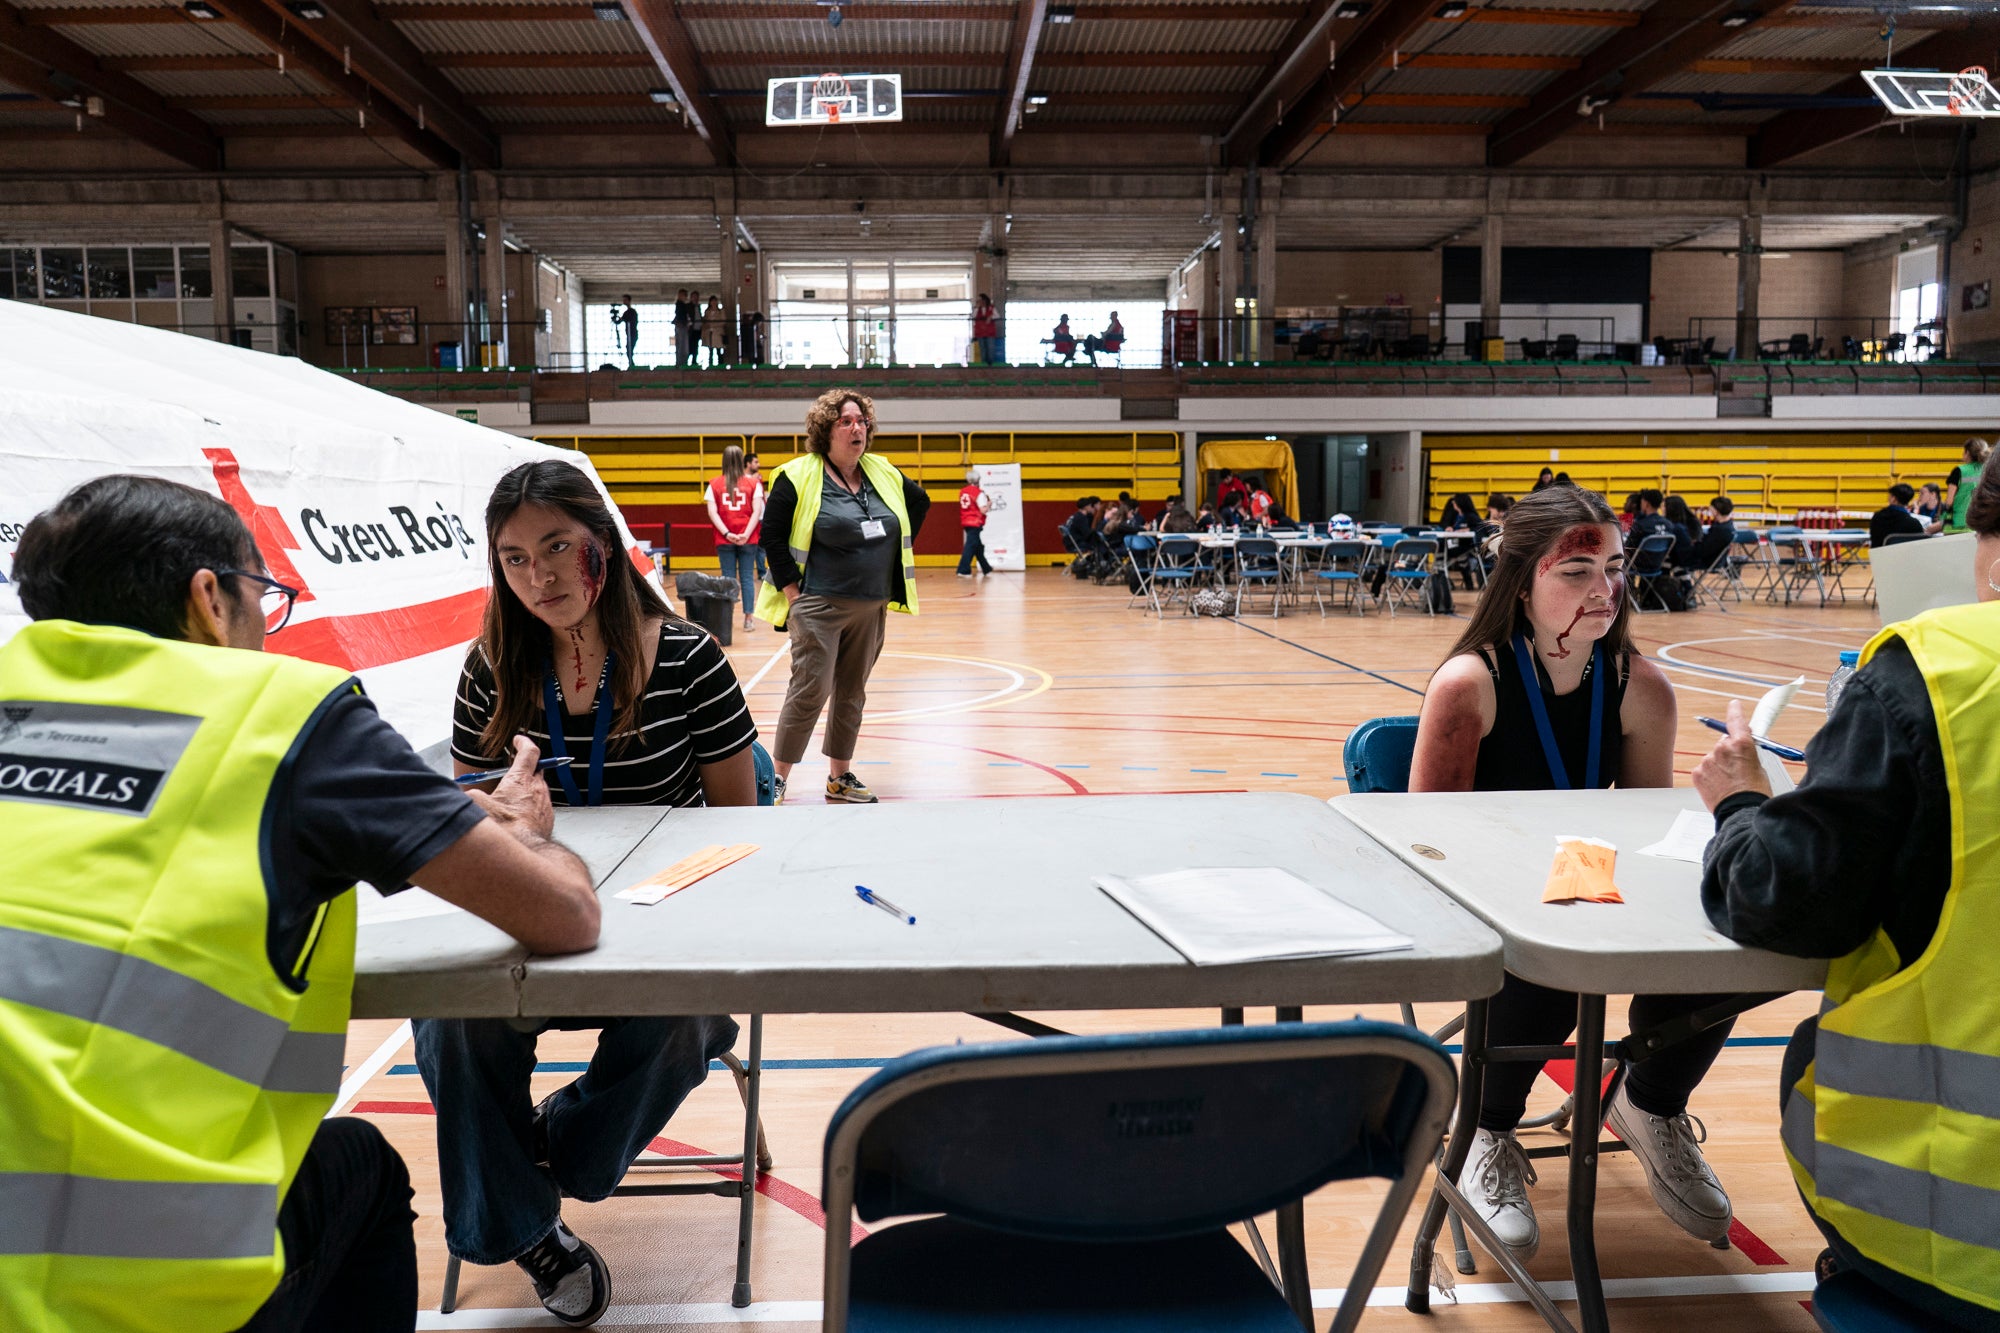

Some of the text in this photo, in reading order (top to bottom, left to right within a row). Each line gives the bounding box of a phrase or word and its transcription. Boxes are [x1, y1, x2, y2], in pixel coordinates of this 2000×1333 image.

[301, 501, 476, 565] Creu Roja
[47, 731, 109, 744] Terrassa
[0, 763, 140, 802] OCIALS
